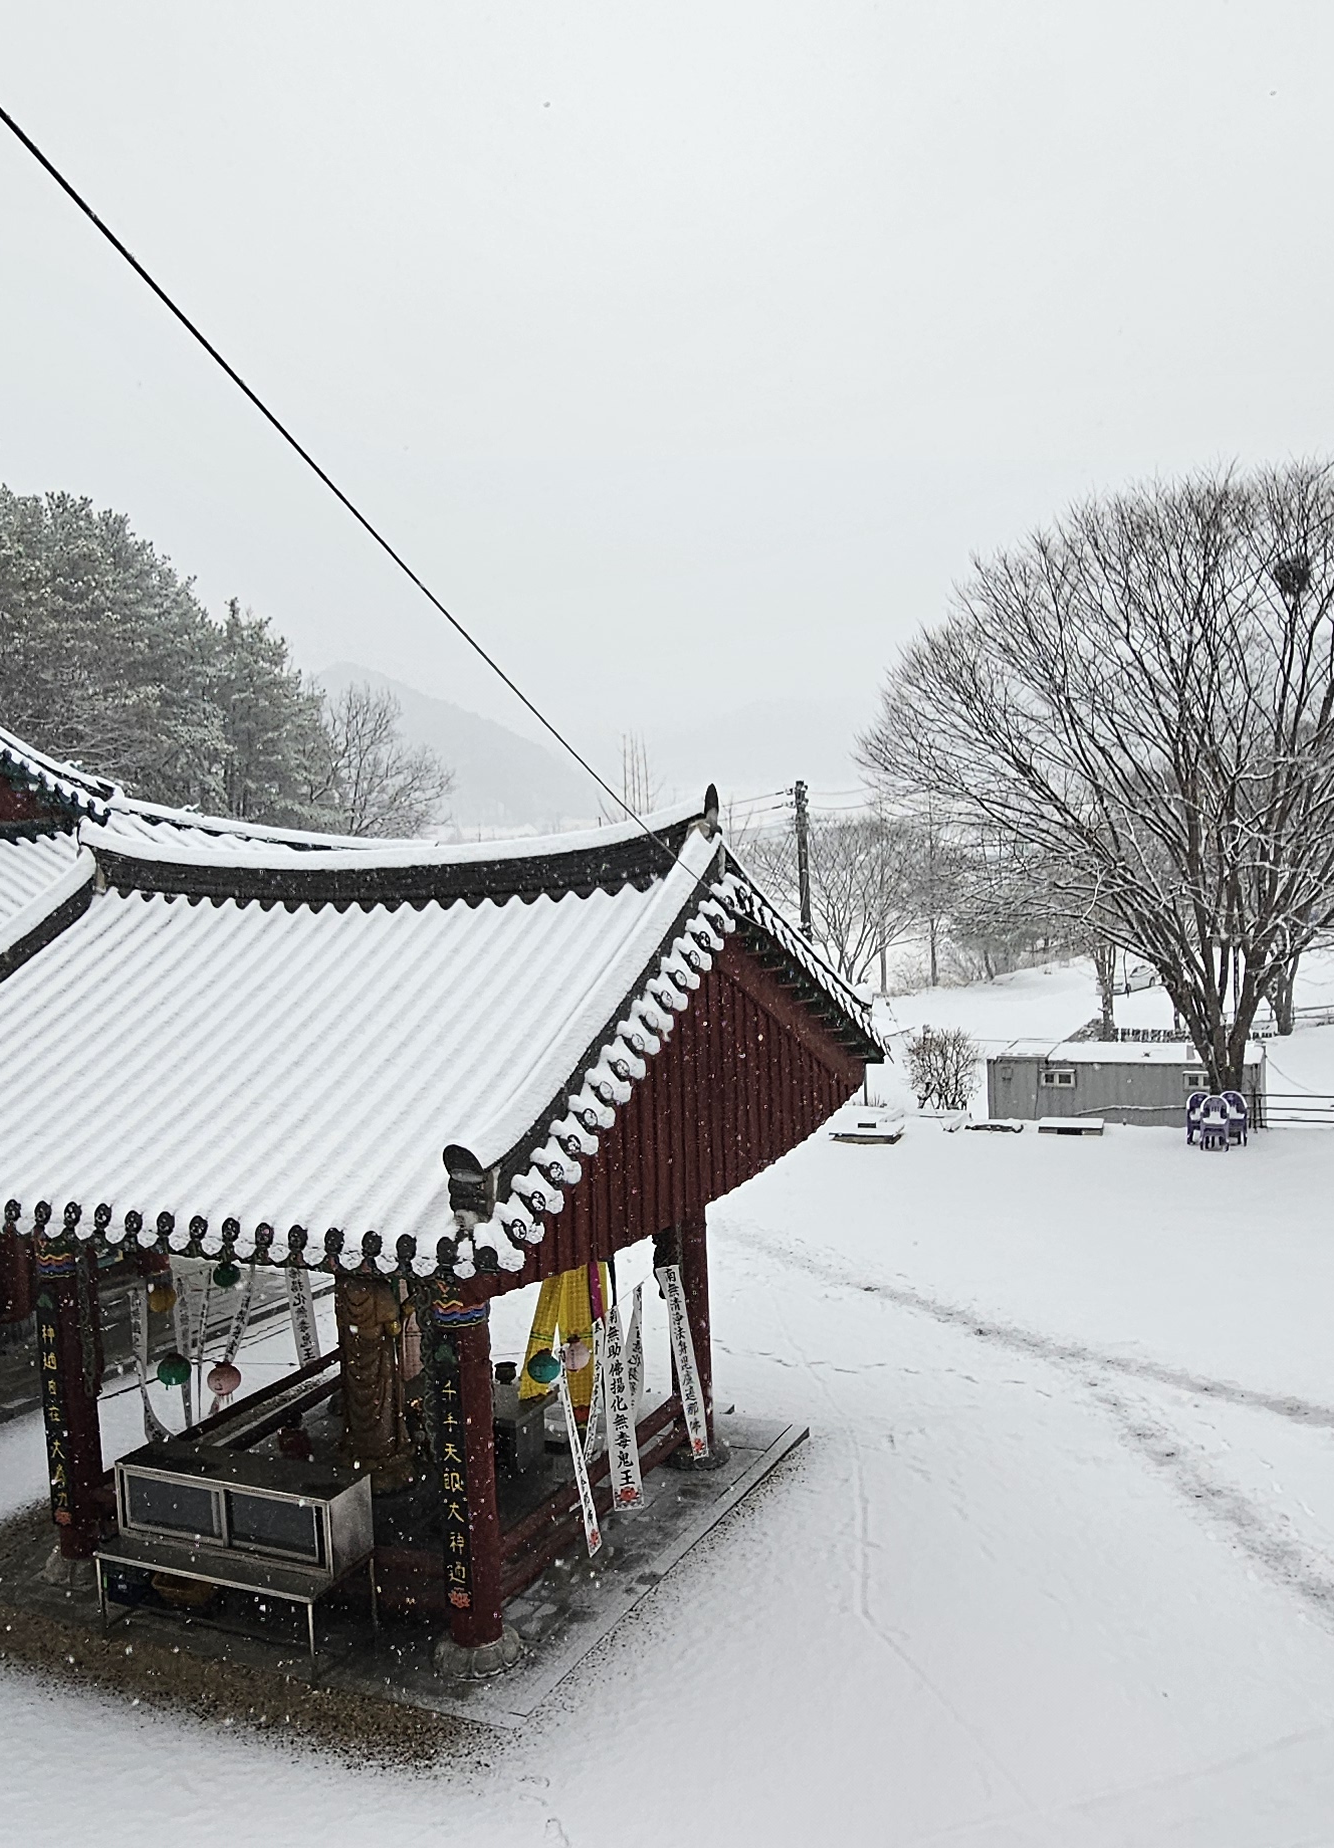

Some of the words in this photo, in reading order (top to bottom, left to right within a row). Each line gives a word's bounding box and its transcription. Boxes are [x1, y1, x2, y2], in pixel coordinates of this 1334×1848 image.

[442, 1379, 466, 1585] 千手天眼大神通
